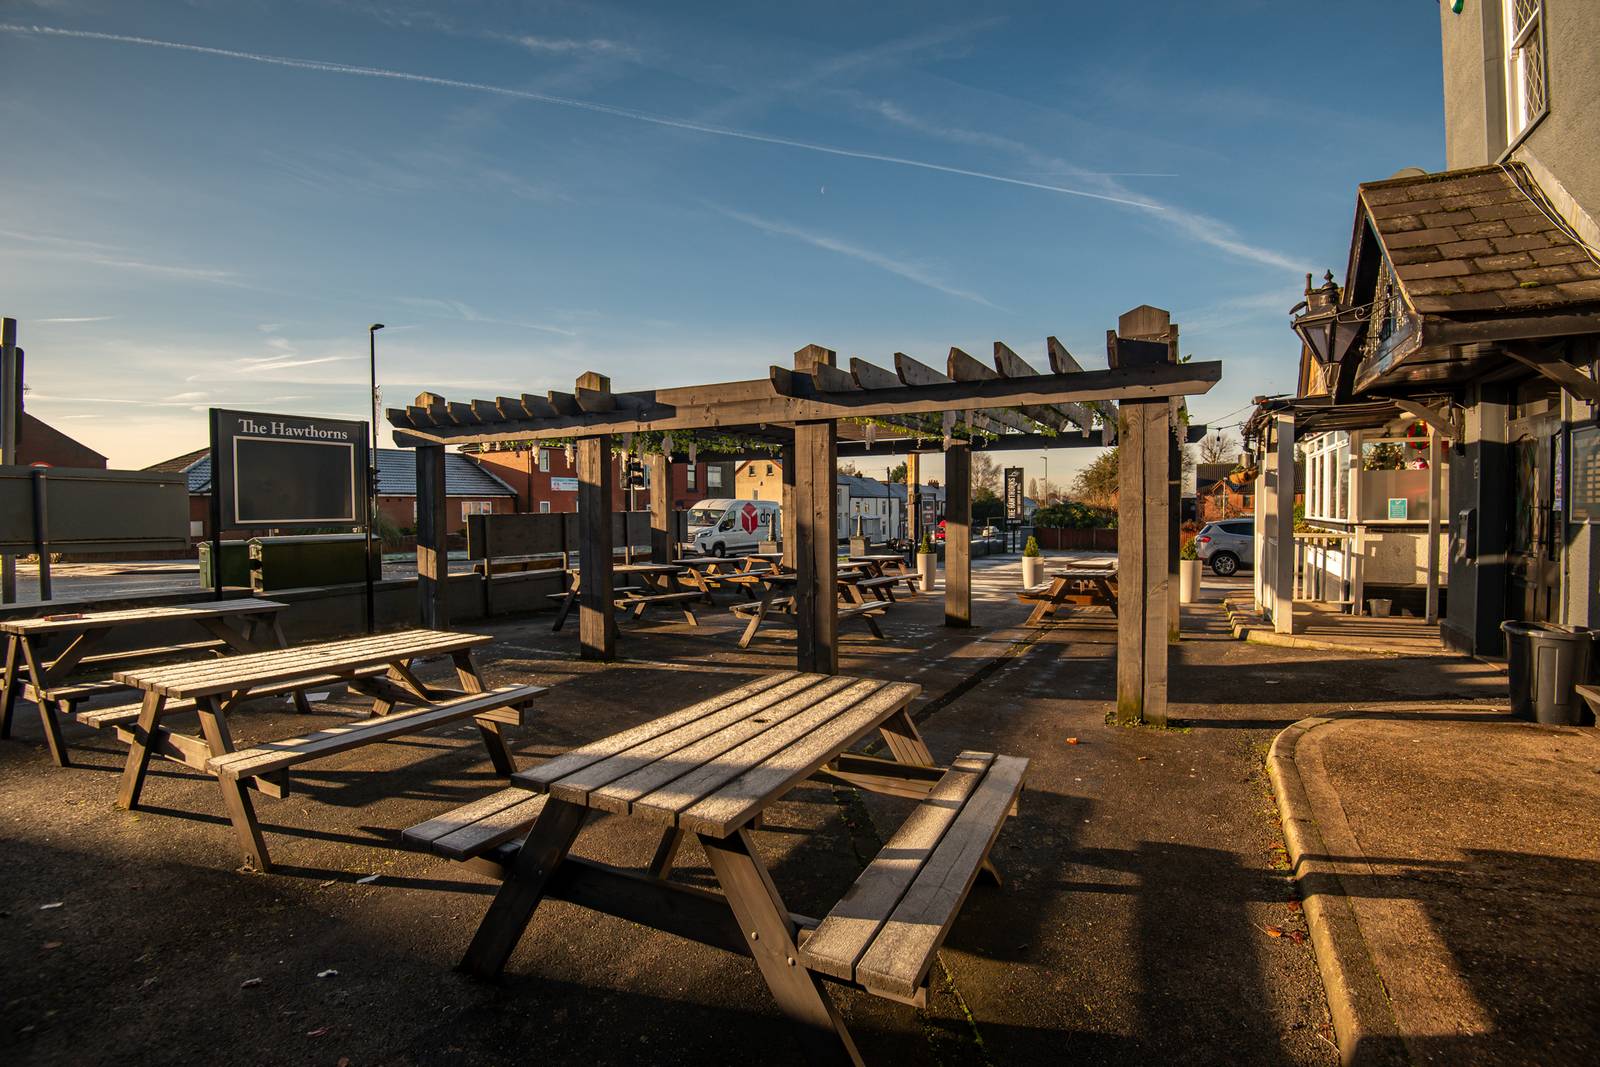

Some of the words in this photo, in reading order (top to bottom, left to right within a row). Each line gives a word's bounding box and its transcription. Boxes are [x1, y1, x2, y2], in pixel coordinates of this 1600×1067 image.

[238, 418, 267, 434] The
[270, 421, 348, 440] Hawthorns
[1007, 508, 1016, 519] THE
